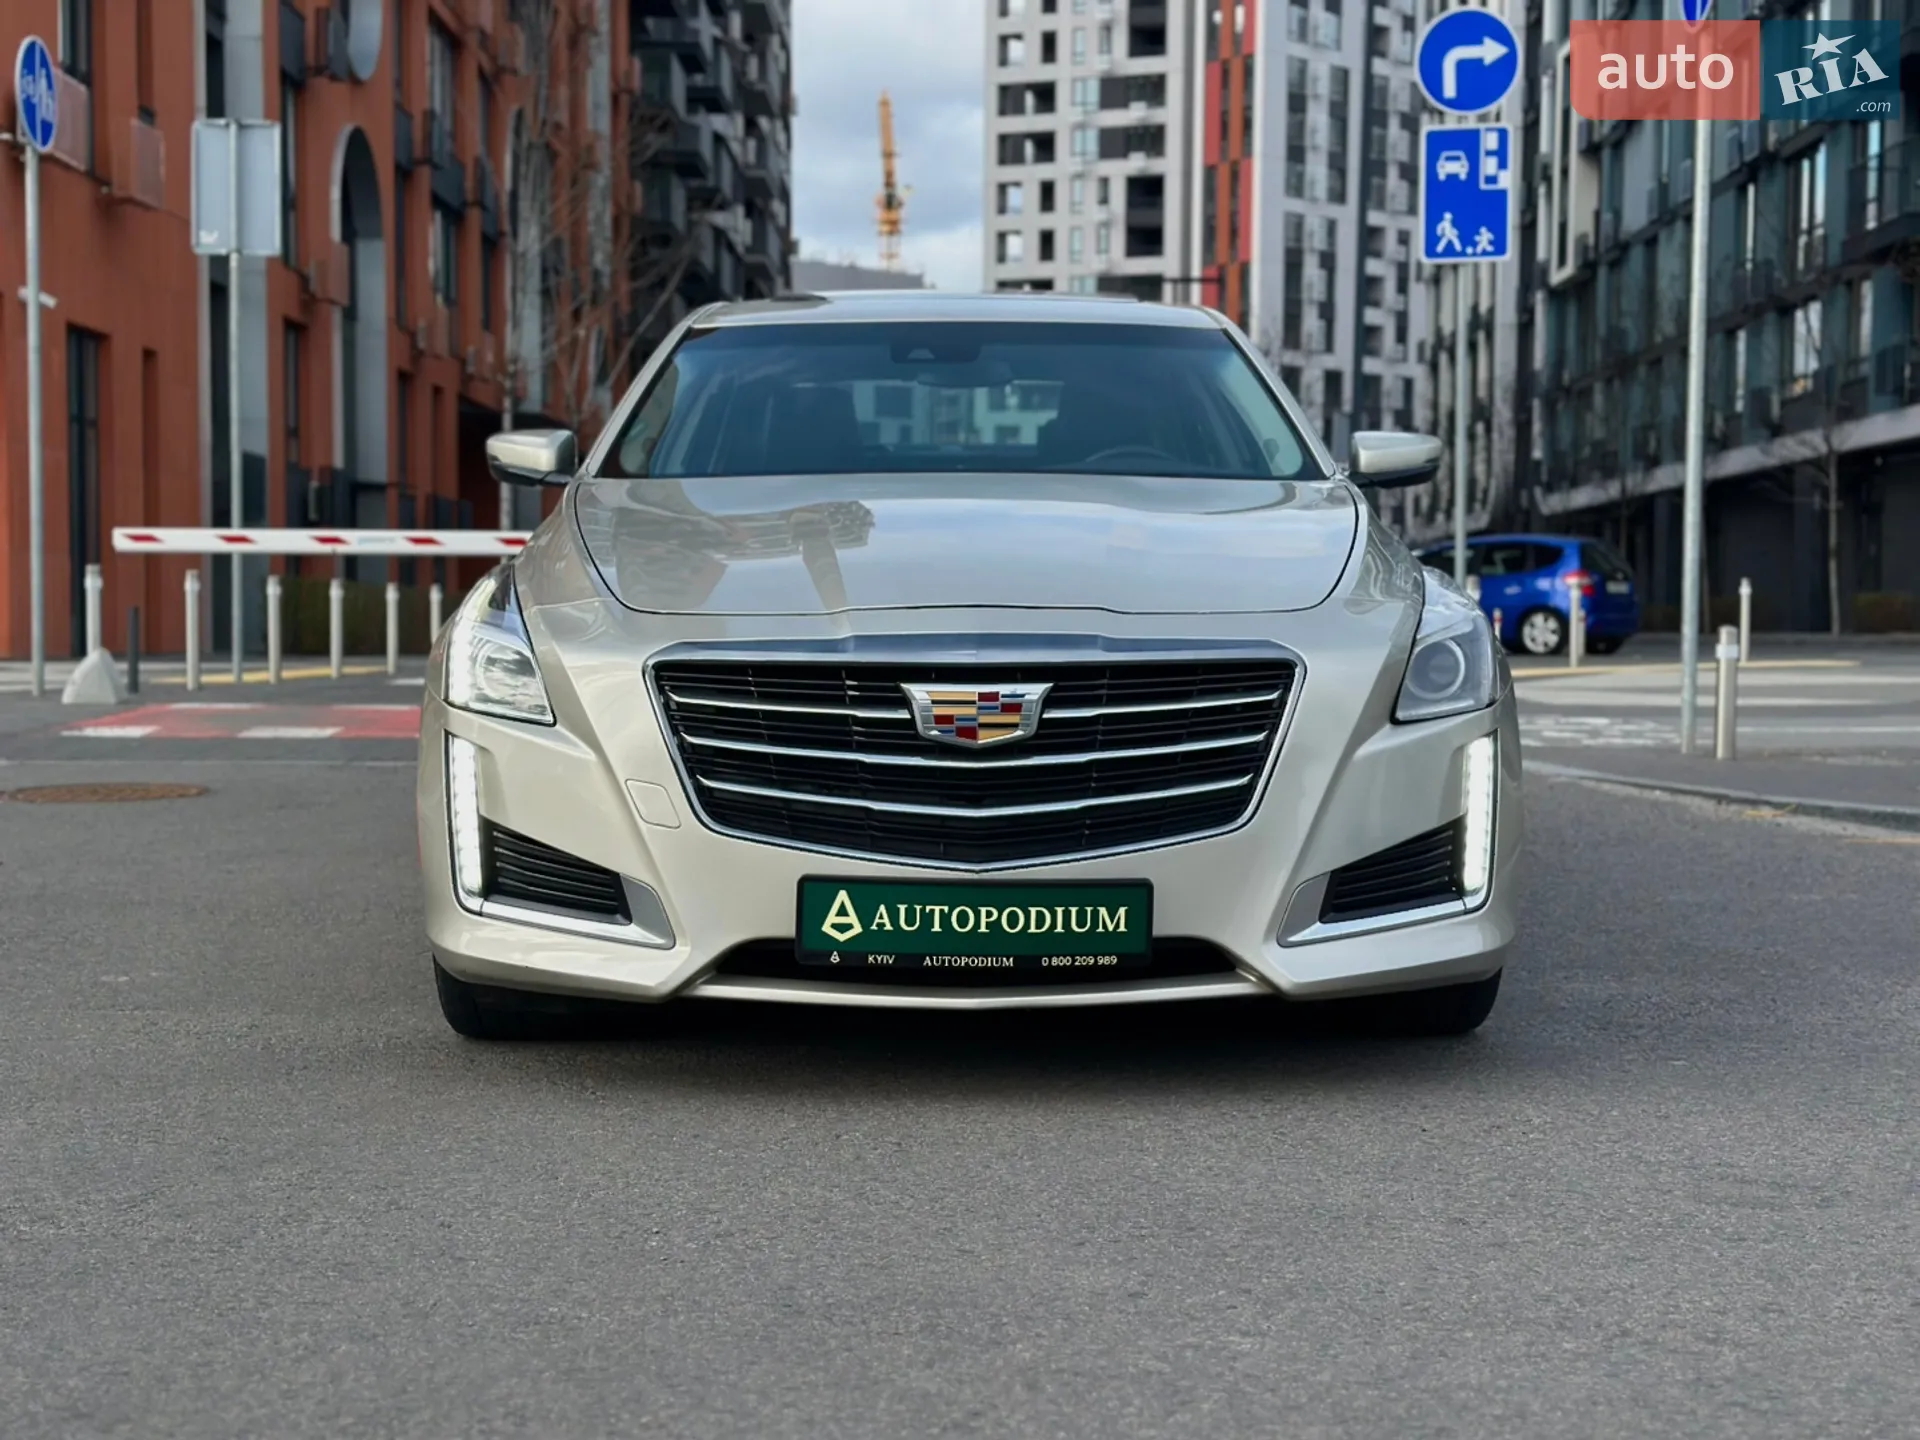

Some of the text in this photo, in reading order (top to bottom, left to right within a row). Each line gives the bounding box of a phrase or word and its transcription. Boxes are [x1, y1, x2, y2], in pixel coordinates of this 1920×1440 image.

[869, 903, 1129, 934] AUTOPODIUM
[867, 954, 1118, 968] KYIV AUTOPODIUM 0 800 209 989
